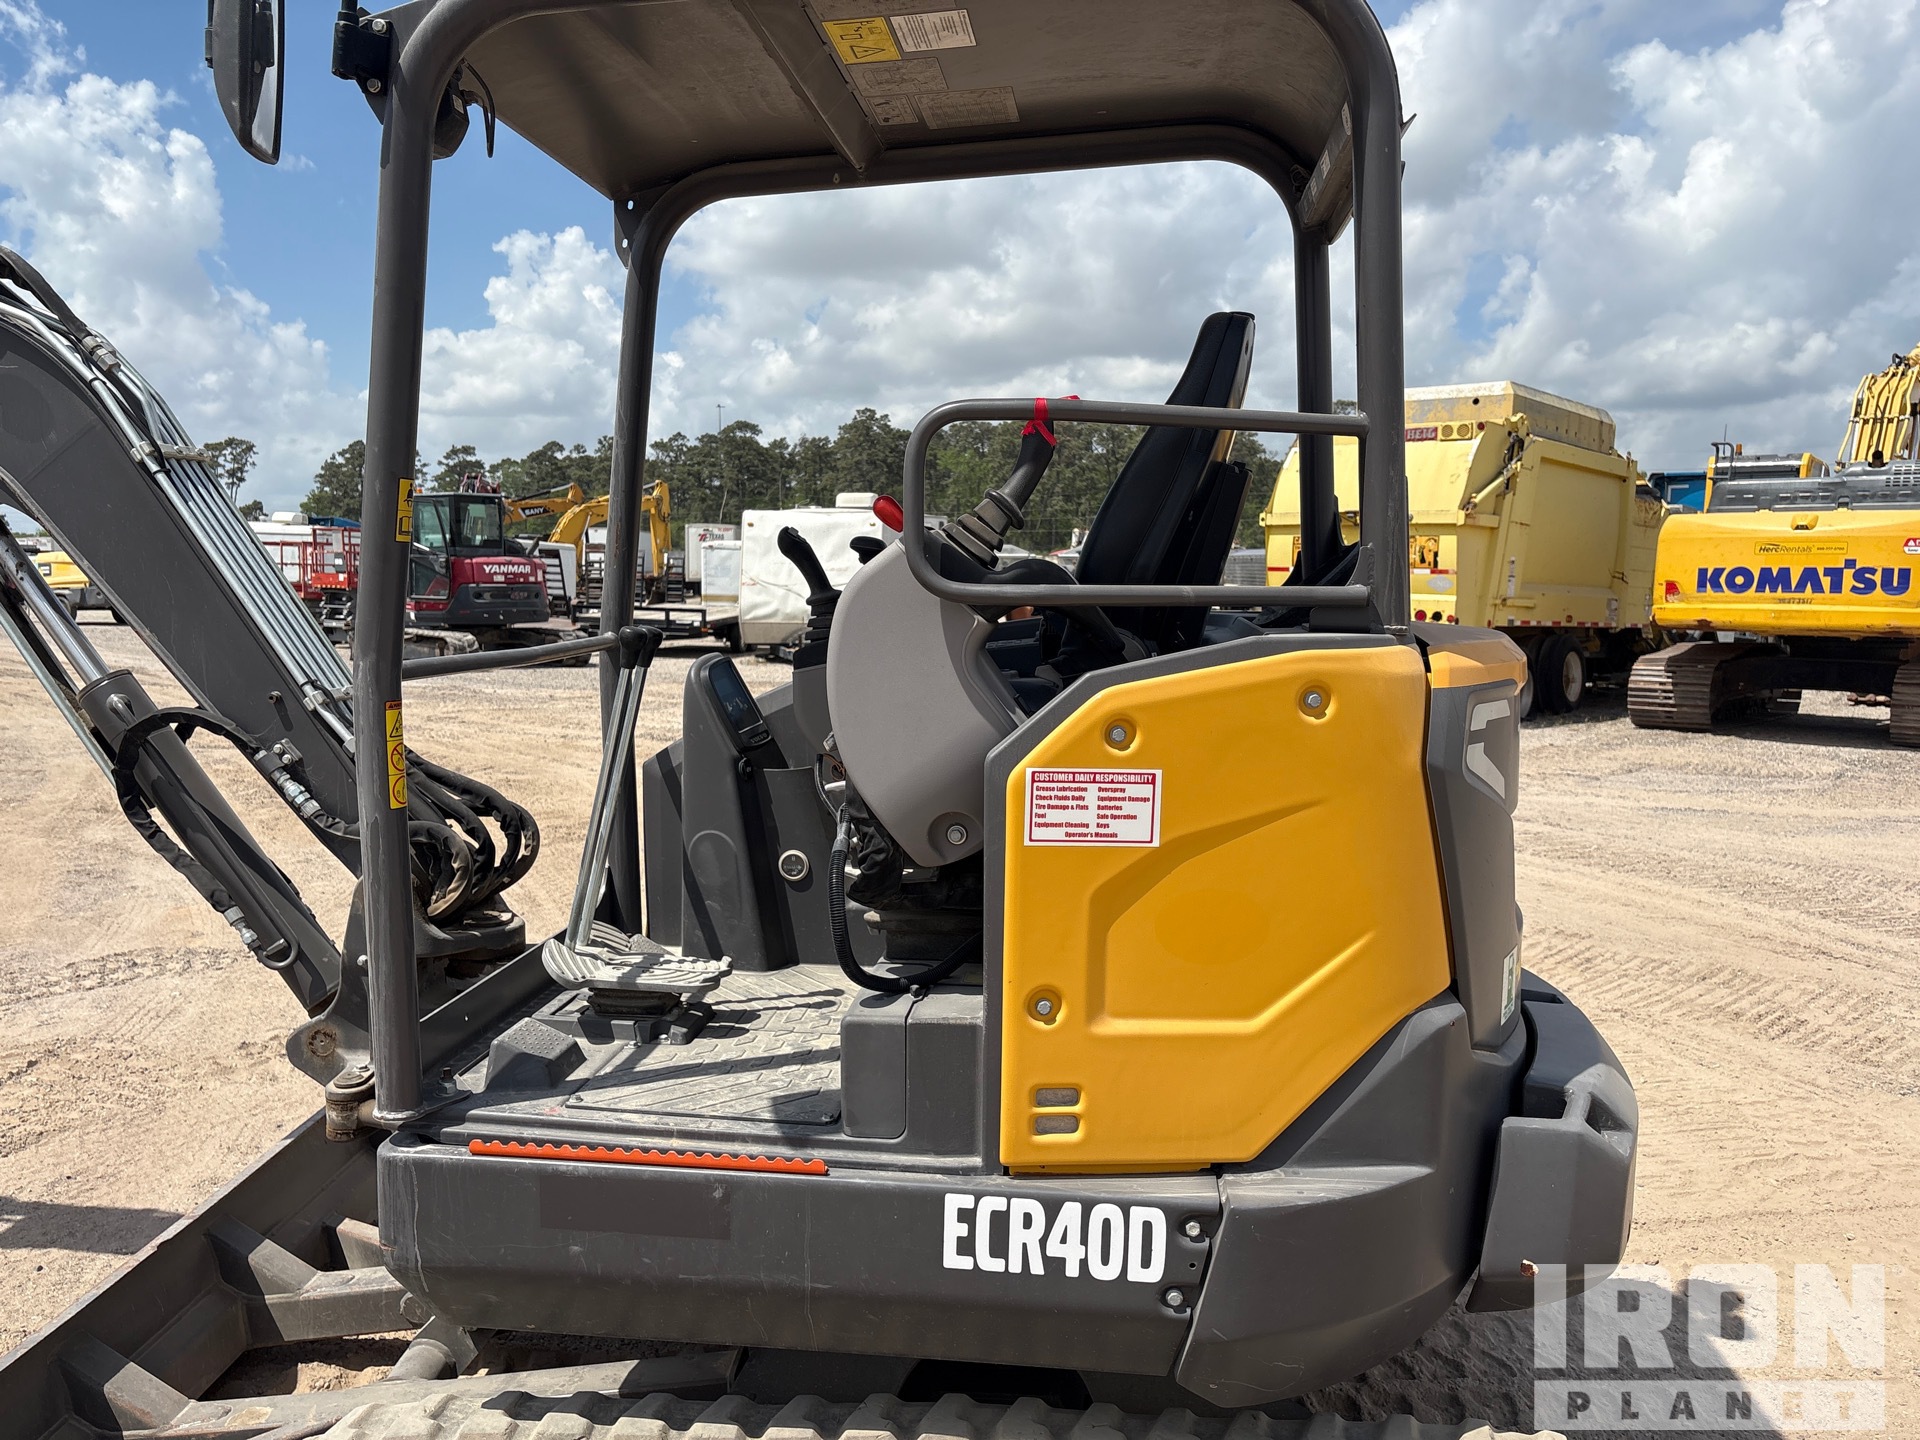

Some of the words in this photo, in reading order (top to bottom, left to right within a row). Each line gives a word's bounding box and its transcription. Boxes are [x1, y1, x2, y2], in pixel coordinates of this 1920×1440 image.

[525, 507, 544, 516] SANY
[483, 564, 531, 574] YANMAR
[1696, 558, 1912, 596] KOMATSU
[1034, 772, 1074, 782] CUSTOMER
[1074, 773, 1095, 782] DAILY
[1095, 774, 1153, 783] RESPONSIBILITY
[943, 1193, 1167, 1283] ECR40D
